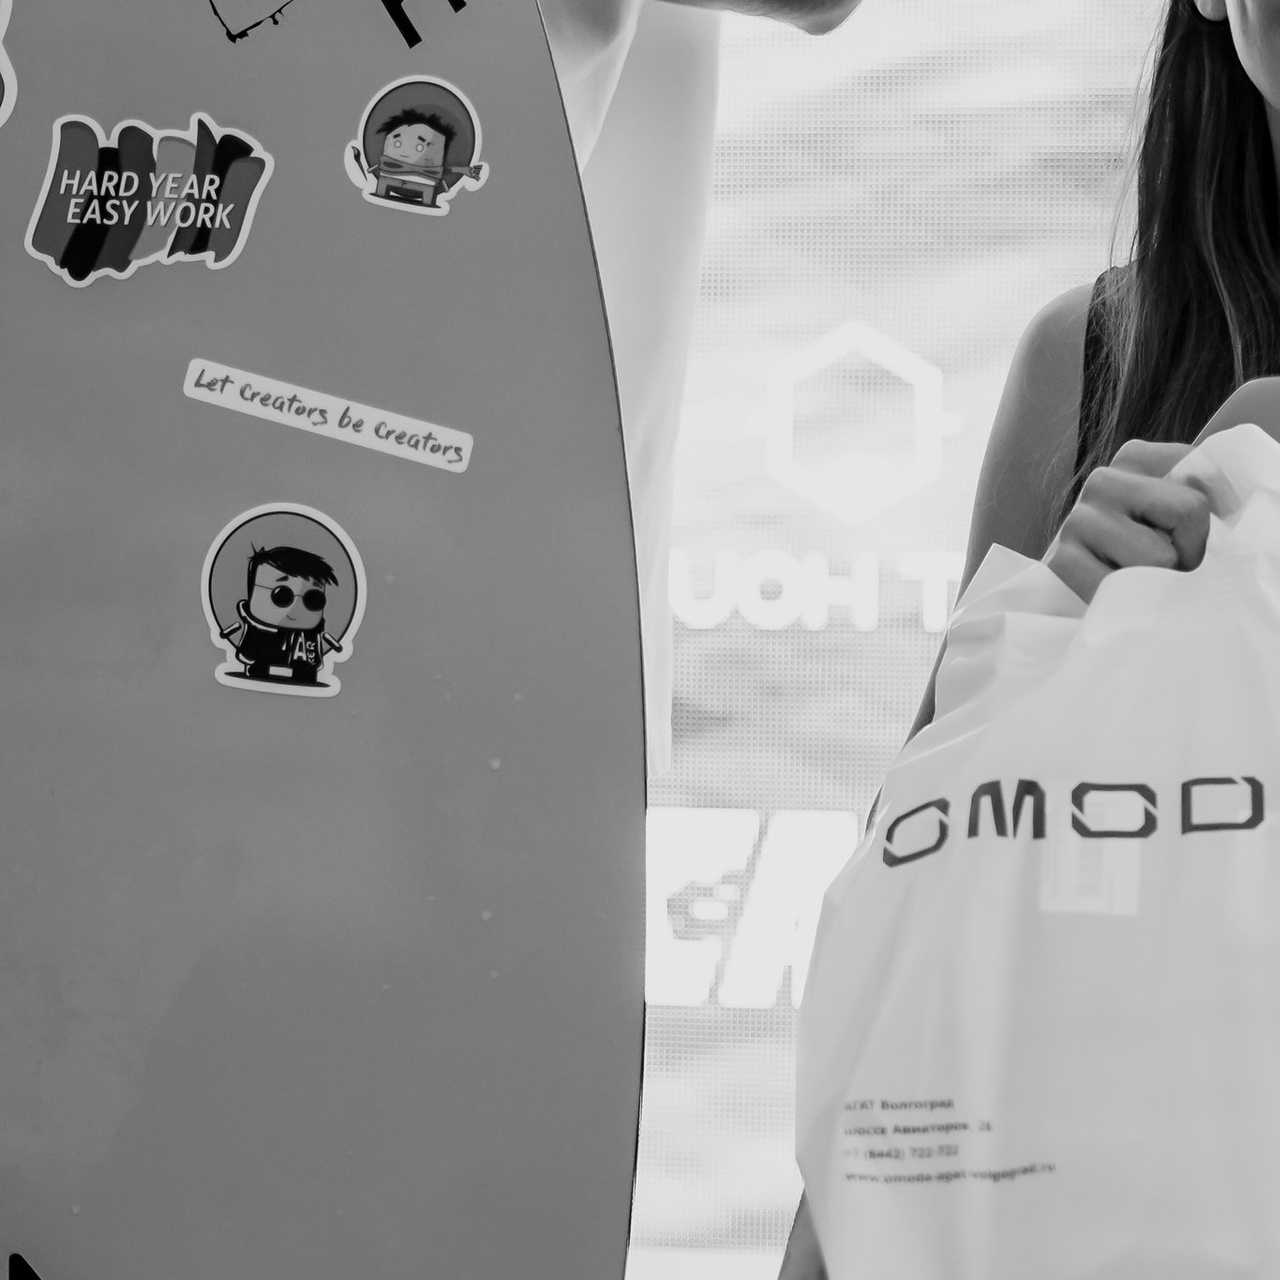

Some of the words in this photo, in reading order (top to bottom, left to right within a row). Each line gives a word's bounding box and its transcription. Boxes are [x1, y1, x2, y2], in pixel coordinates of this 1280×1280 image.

[59, 169, 140, 197] HARD
[149, 172, 221, 200] YEAR
[66, 198, 140, 226] EASY
[146, 200, 235, 230] WORK
[194, 368, 235, 394] Let
[338, 406, 365, 433] be
